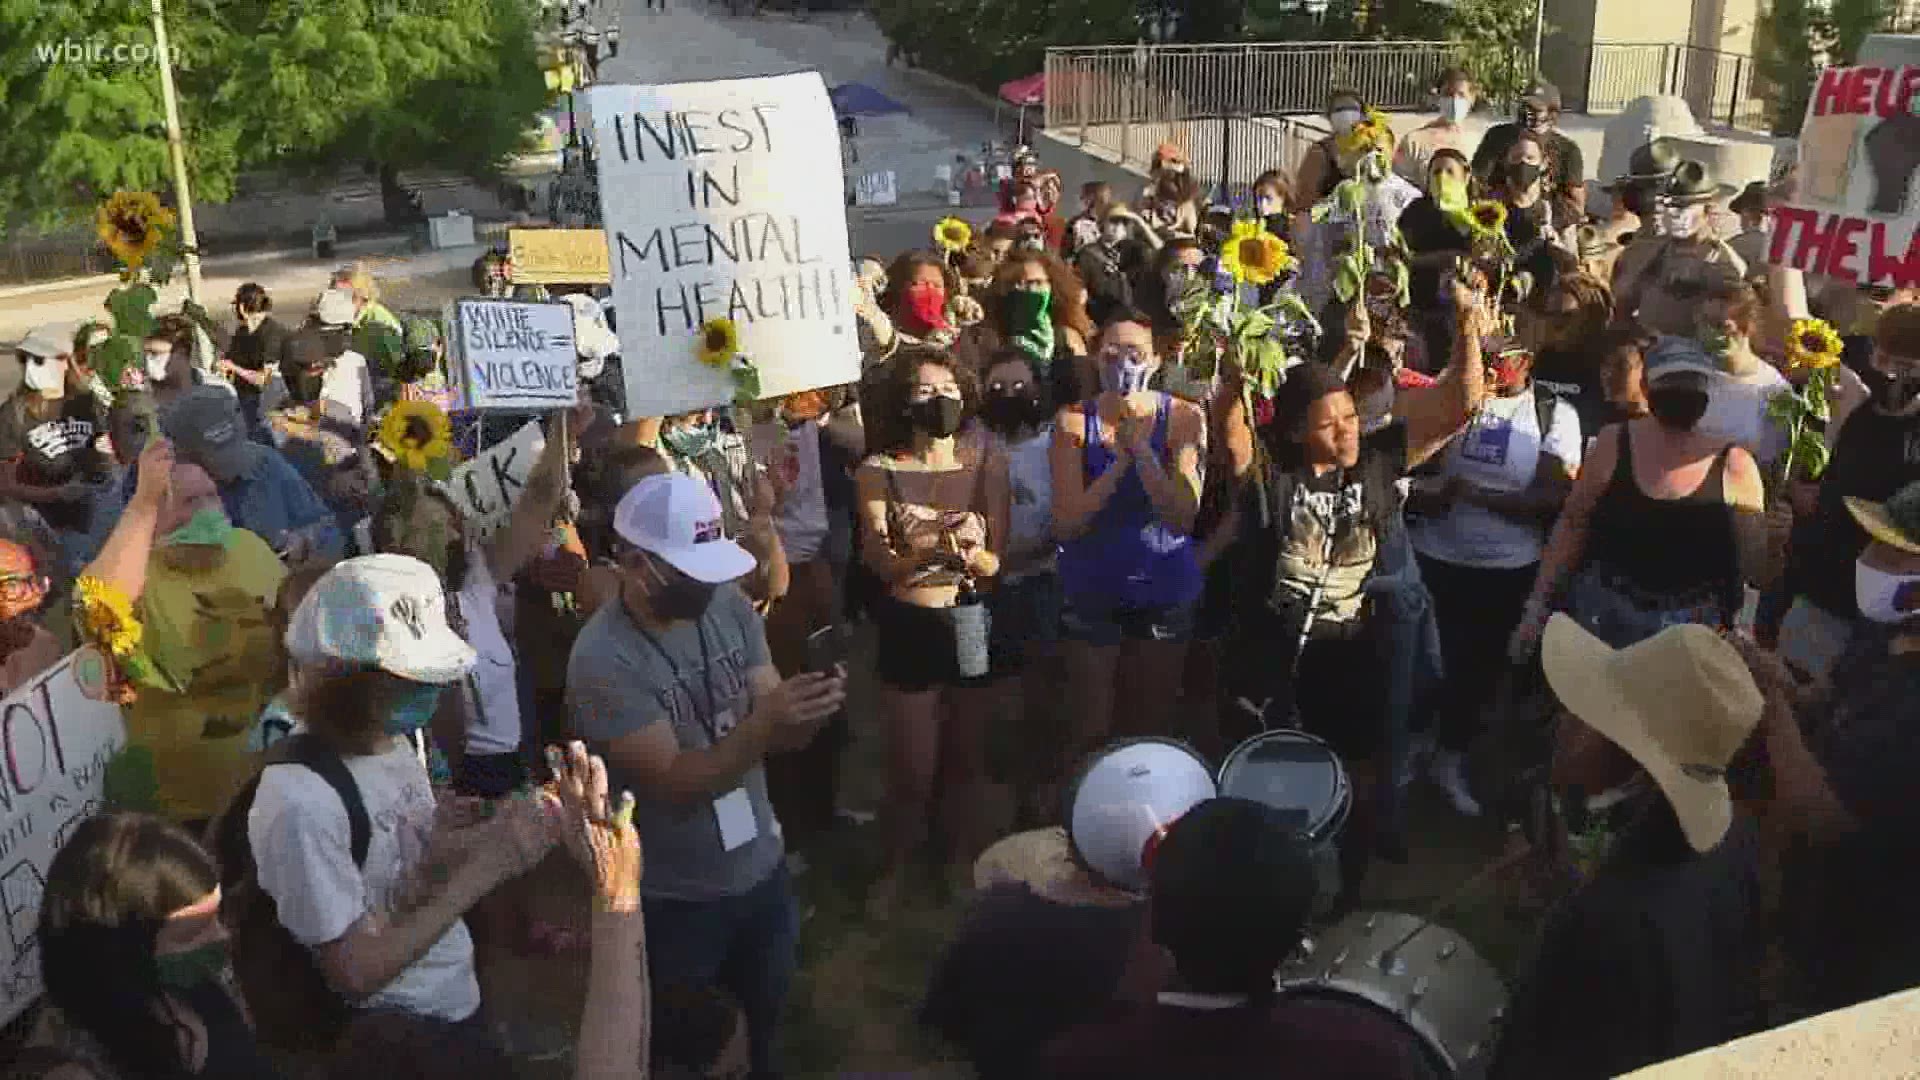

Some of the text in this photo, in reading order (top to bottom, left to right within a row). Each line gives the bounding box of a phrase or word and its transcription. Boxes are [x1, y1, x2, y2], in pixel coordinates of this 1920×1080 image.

[687, 162, 740, 208] IN
[615, 212, 823, 277] MENTAL
[463, 304, 532, 331] WHITE
[474, 360, 574, 391] VIOLENCE
